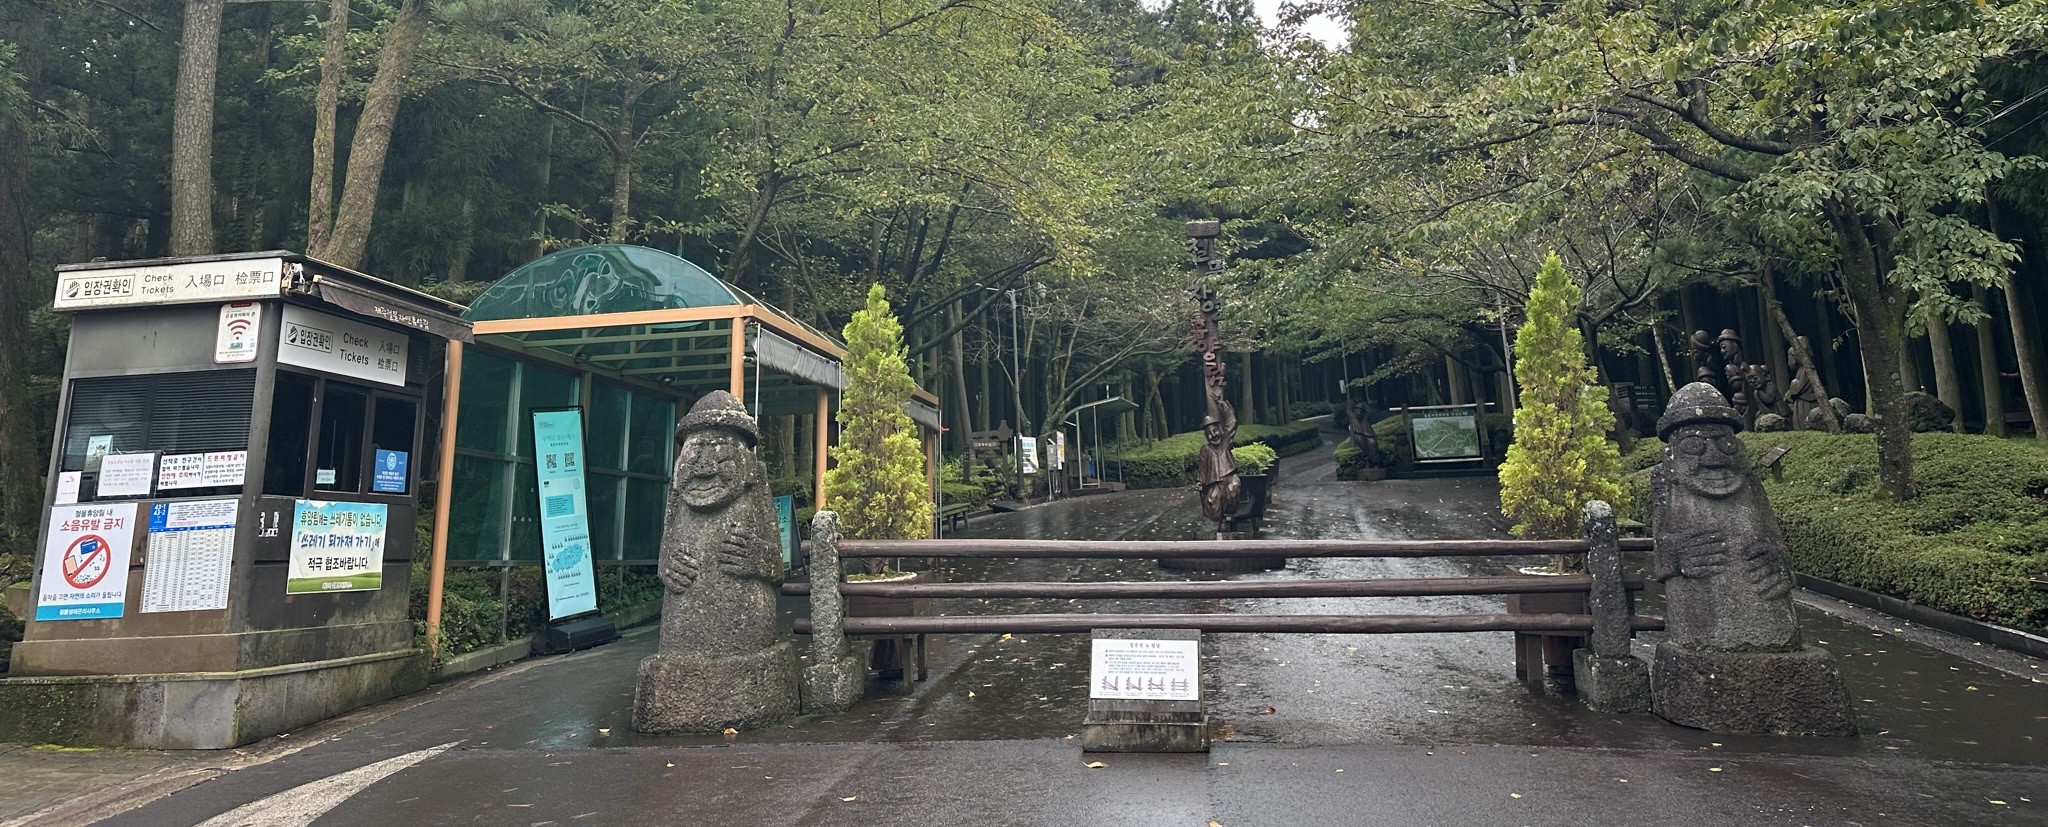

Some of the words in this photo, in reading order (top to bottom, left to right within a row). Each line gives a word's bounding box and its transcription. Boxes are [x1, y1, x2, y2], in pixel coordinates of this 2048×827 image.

[144, 273, 173, 282] Check
[184, 274, 225, 288] 入場口
[84, 279, 131, 296] 입장권확인
[141, 285, 174, 295] Tickets
[300, 329, 331, 350] 입장권확인
[343, 332, 368, 348] Check
[340, 349, 369, 365] Tickets
[75, 509, 105, 518] 절물휴양림
[107, 508, 113, 516] 내
[300, 510, 328, 526] 휴양림에는
[329, 512, 358, 527] 쓰레기통이
[360, 513, 383, 528] 없습니다.
[60, 518, 101, 532] 소음유발
[103, 517, 124, 530] 금지
[328, 533, 353, 548] 되가져
[308, 556, 323, 571] 적극
[325, 556, 369, 571] 협조바랍니다.
